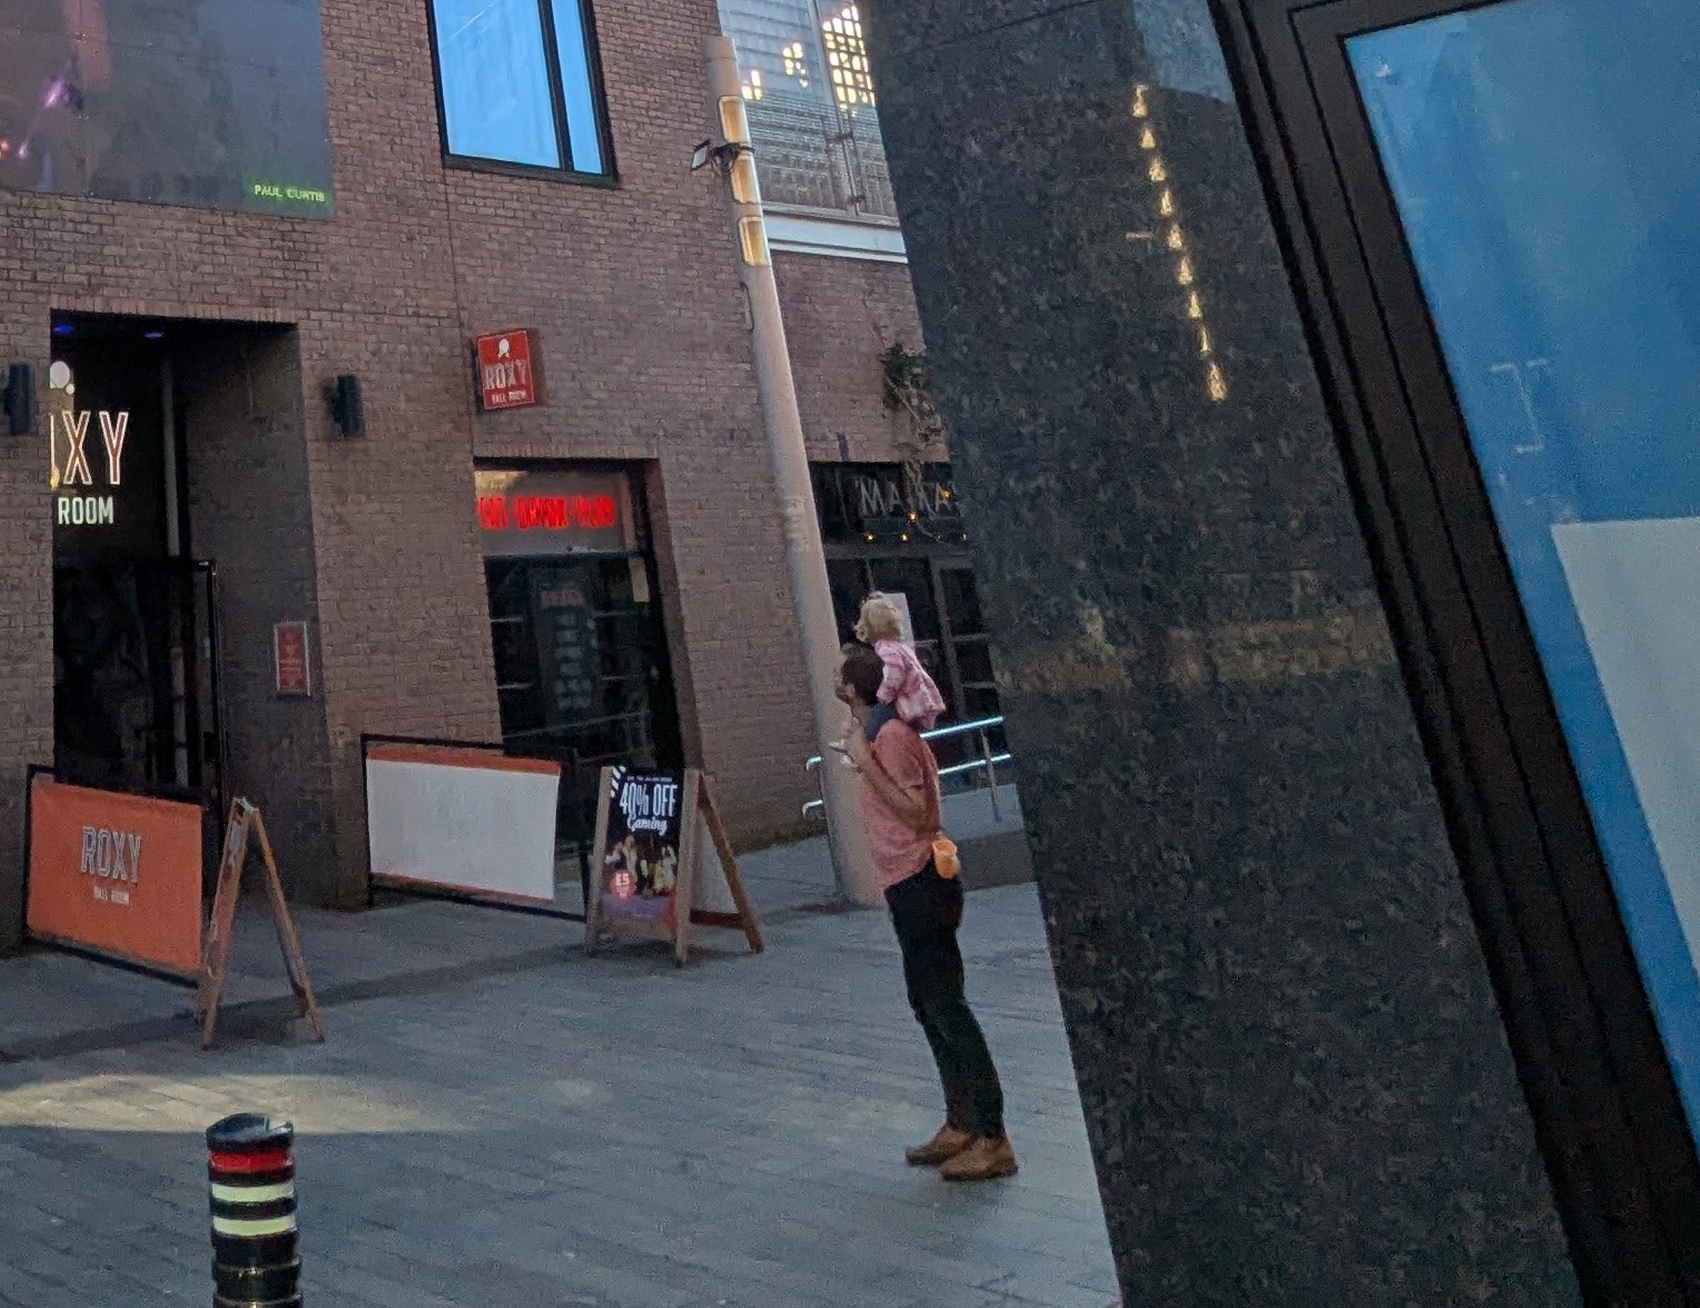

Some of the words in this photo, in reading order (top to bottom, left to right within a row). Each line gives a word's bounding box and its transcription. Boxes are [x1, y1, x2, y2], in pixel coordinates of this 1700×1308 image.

[254, 184, 283, 197] PAUL
[286, 189, 325, 202] CURTIS
[483, 359, 527, 390] ROXY
[49, 410, 129, 485] XY
[57, 496, 114, 525] ROOM
[619, 782, 649, 815] 40%
[652, 783, 678, 817] OFF
[81, 825, 142, 884] ROXY
